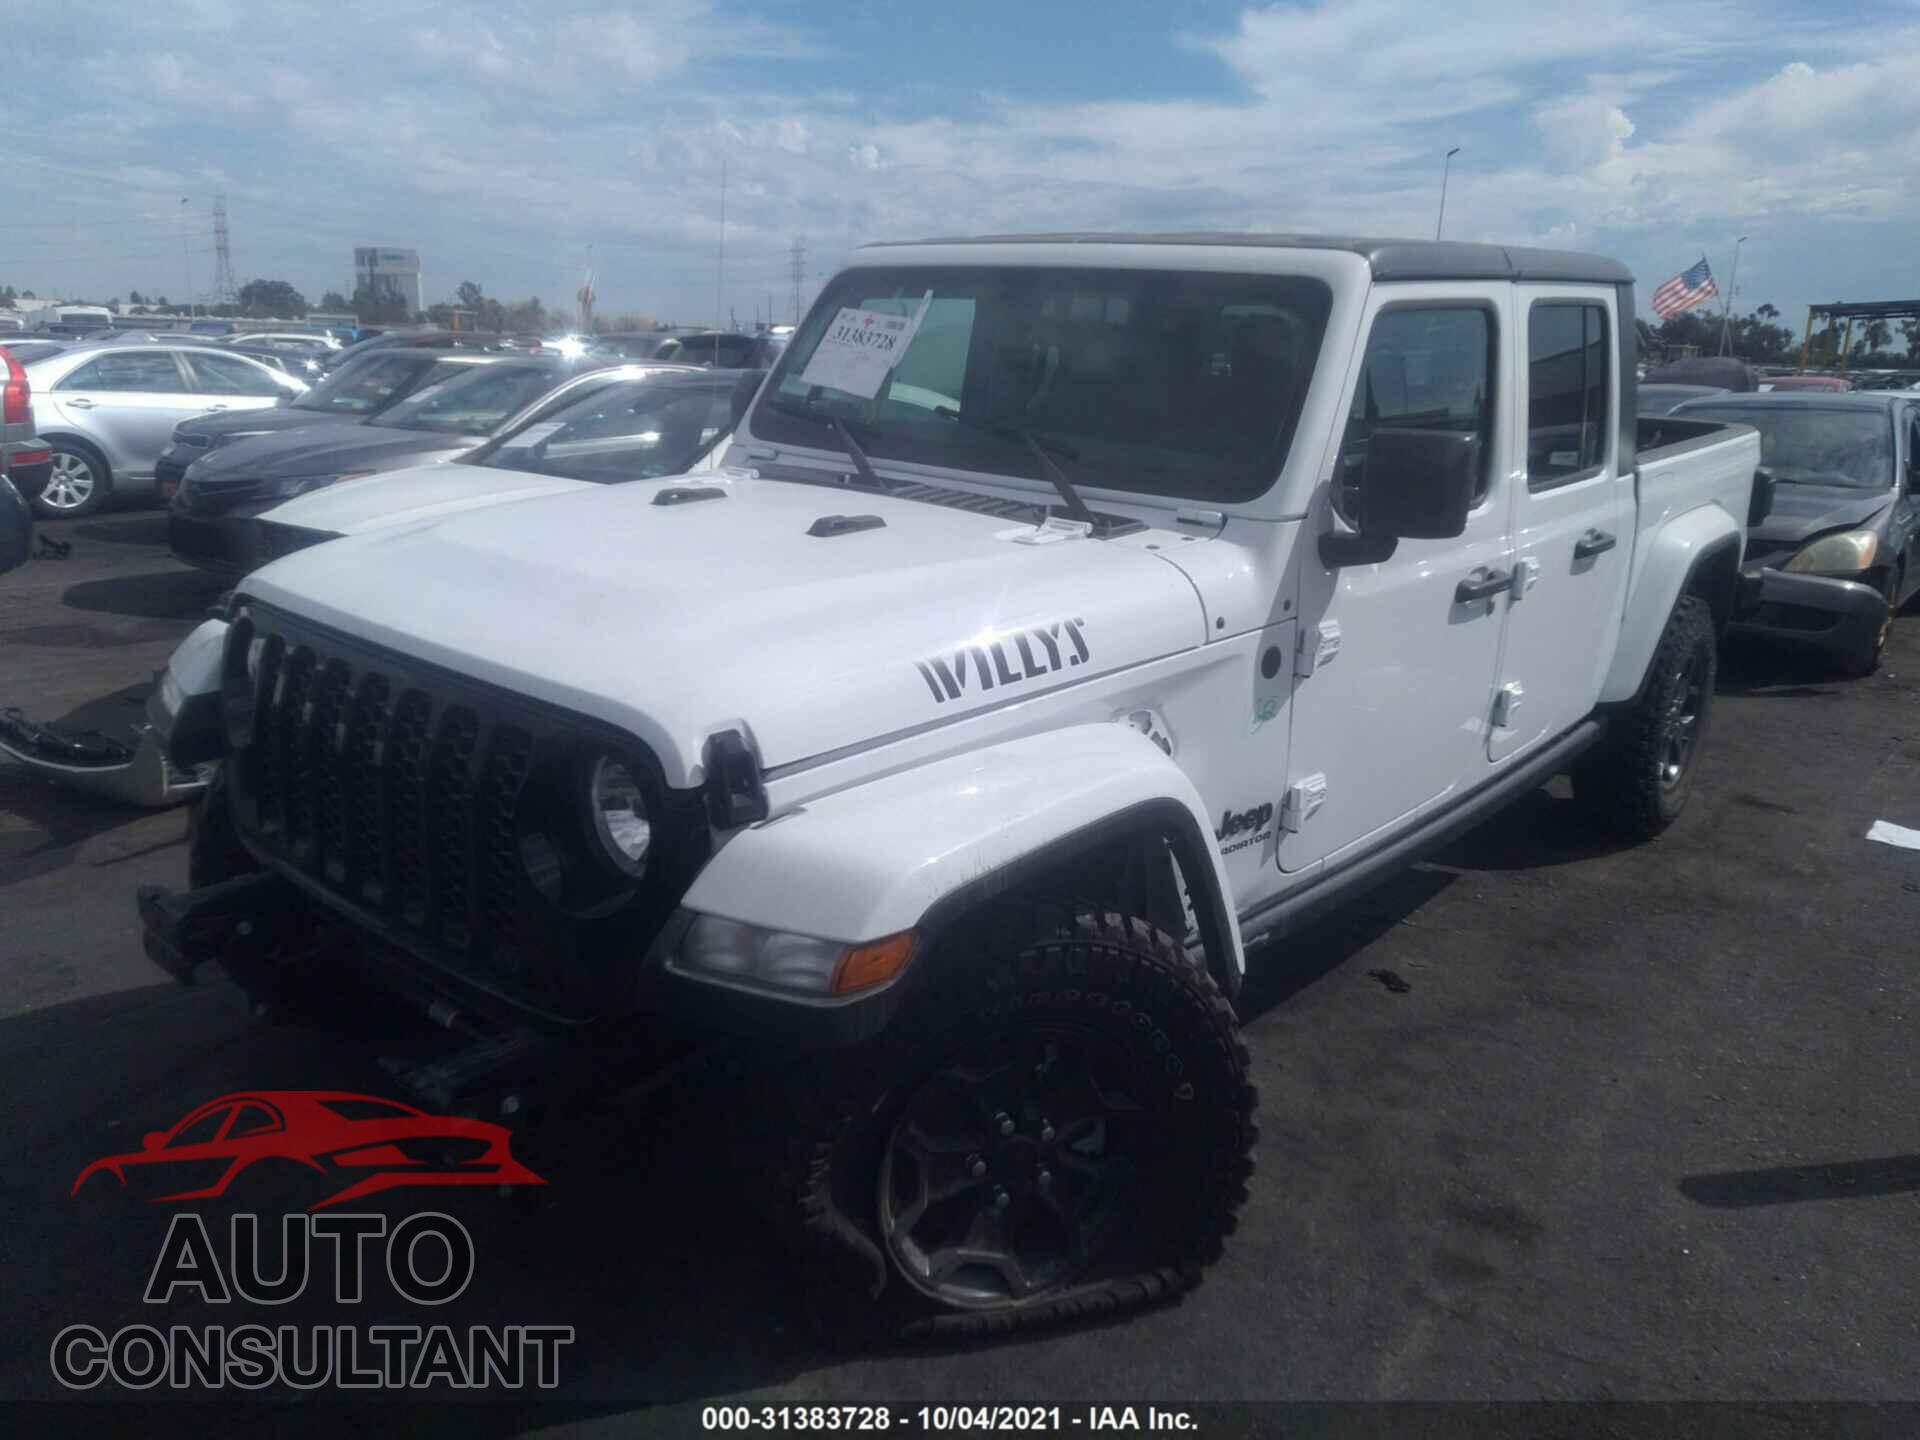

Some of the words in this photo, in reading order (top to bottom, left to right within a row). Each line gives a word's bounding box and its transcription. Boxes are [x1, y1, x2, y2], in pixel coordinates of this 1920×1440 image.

[833, 325, 896, 351] 31383728
[914, 617, 1090, 704] WILLYS
[1215, 802, 1273, 842] Jeep
